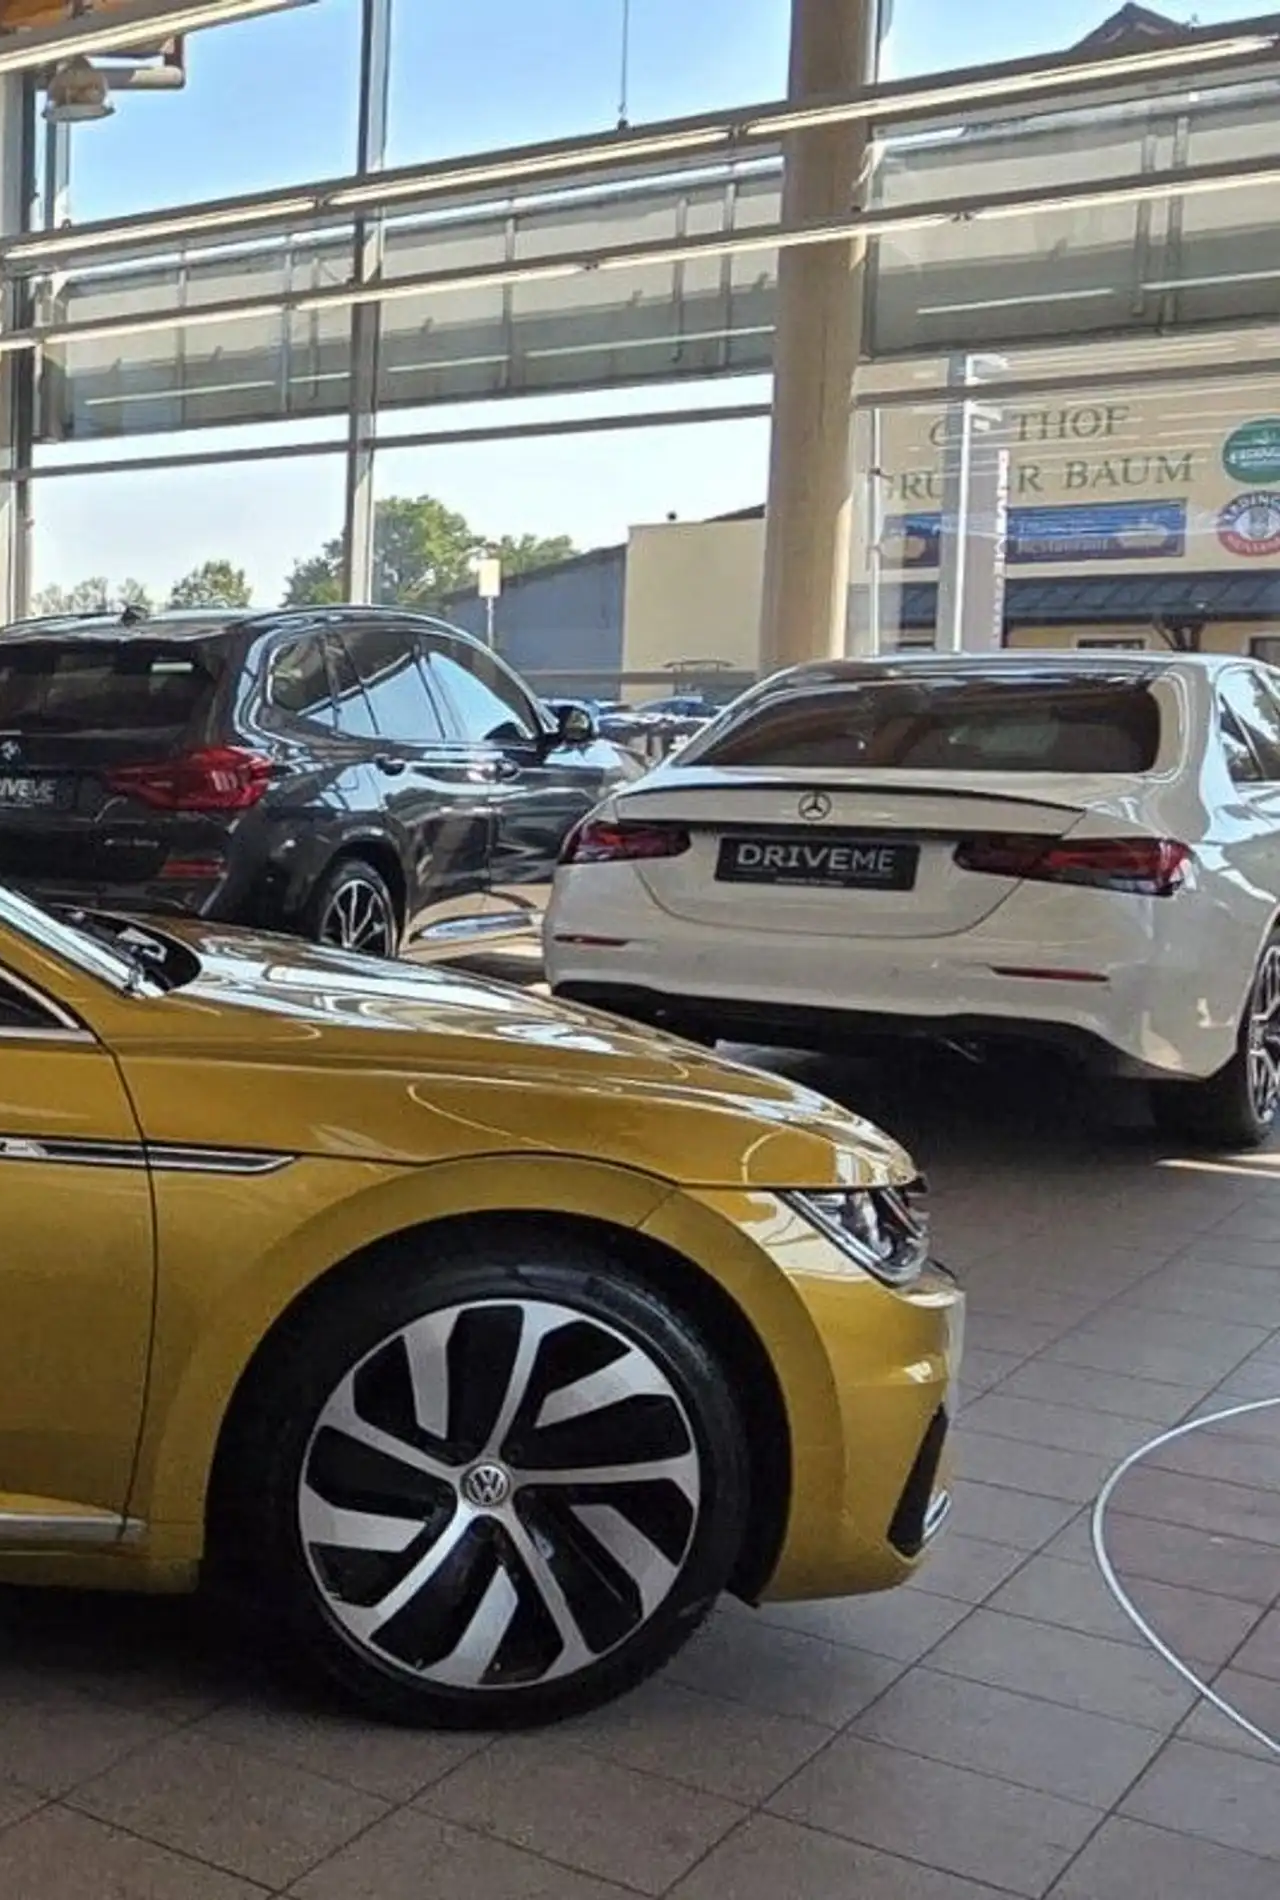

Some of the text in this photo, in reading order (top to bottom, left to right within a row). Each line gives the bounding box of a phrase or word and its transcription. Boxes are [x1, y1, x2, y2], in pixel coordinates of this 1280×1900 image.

[928, 406, 1130, 447] GTHOF
[1065, 453, 1195, 489] BAUM
[736, 843, 897, 871] DRIVEME
